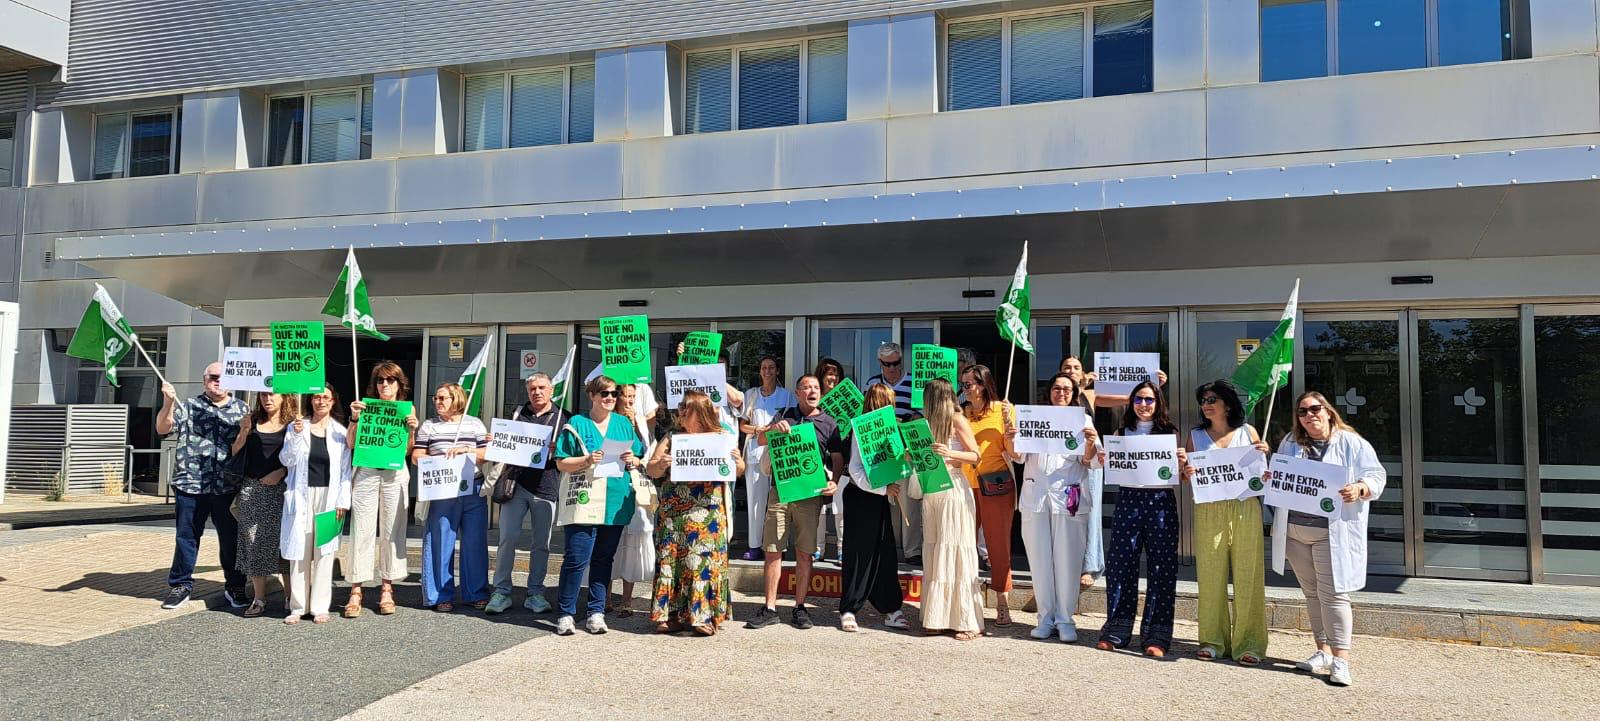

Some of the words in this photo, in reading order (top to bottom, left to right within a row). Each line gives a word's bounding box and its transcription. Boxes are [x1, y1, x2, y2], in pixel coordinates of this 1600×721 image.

[604, 326, 620, 334] QUE
[622, 324, 634, 333] NO
[275, 331, 293, 339] QUE
[296, 330, 308, 339] NO
[605, 336, 614, 344] SE
[616, 333, 645, 343] COMAN
[276, 341, 286, 350] SE
[288, 341, 320, 350] COMAN
[606, 346, 614, 354] NI
[616, 345, 628, 354] UN
[276, 352, 285, 361] NI
[288, 352, 300, 361] UN
[692, 347, 717, 357] COMAN
[916, 352, 931, 360] QUE
[933, 352, 944, 360] NO
[236, 361, 257, 369] EXTRA
[606, 355, 628, 365] EURO
[276, 362, 300, 372] EURO
[915, 361, 925, 369] SE
[926, 361, 954, 370] COMAN
[246, 369, 262, 377] TOCA
[915, 371, 924, 379] NI
[925, 371, 937, 379] UN
[670, 379, 697, 388] EXTRAS
[915, 380, 925, 389] EU
[384, 407, 397, 417] NO
[362, 415, 373, 424] SE
[376, 416, 407, 428] COMAN
[858, 422, 873, 435] QUE
[874, 418, 885, 429] NO
[1020, 421, 1051, 429] EXTRAS
[361, 425, 370, 435] NI
[373, 427, 386, 436] UN
[861, 435, 870, 446] SE
[871, 425, 896, 442] COMAN
[1020, 429, 1033, 438] SIN
[1035, 430, 1073, 439] RECORTES
[359, 435, 384, 447] EURO
[494, 433, 509, 441] POR
[510, 435, 546, 447] NUESTRAS
[771, 437, 787, 448] QUE
[789, 434, 802, 444] NO
[492, 440, 517, 451] PAGAS
[773, 449, 783, 460] SE
[785, 441, 816, 457] COMAN
[676, 449, 705, 457] EXTRAS
[1109, 451, 1126, 460] POR
[1128, 451, 1172, 460] NUESTRAS
[676, 458, 688, 466] SIN
[690, 458, 726, 466] RECORTES
[775, 459, 785, 470] NI
[786, 456, 799, 468] UN
[1109, 461, 1138, 470] PAGAS
[432, 468, 453, 477] EXTRA
[777, 467, 802, 481] EURO
[1195, 468, 1205, 476] MI
[1207, 464, 1235, 475] EXTRA
[434, 477, 442, 485] SE
[1197, 477, 1208, 486] NO
[1211, 475, 1221, 484] SE
[1222, 472, 1244, 483] TOCA
[1273, 471, 1283, 480] DE
[1285, 473, 1295, 482] MI
[1272, 480, 1281, 489] NI
[1282, 482, 1294, 492] UN
[1296, 485, 1318, 497] EURO
